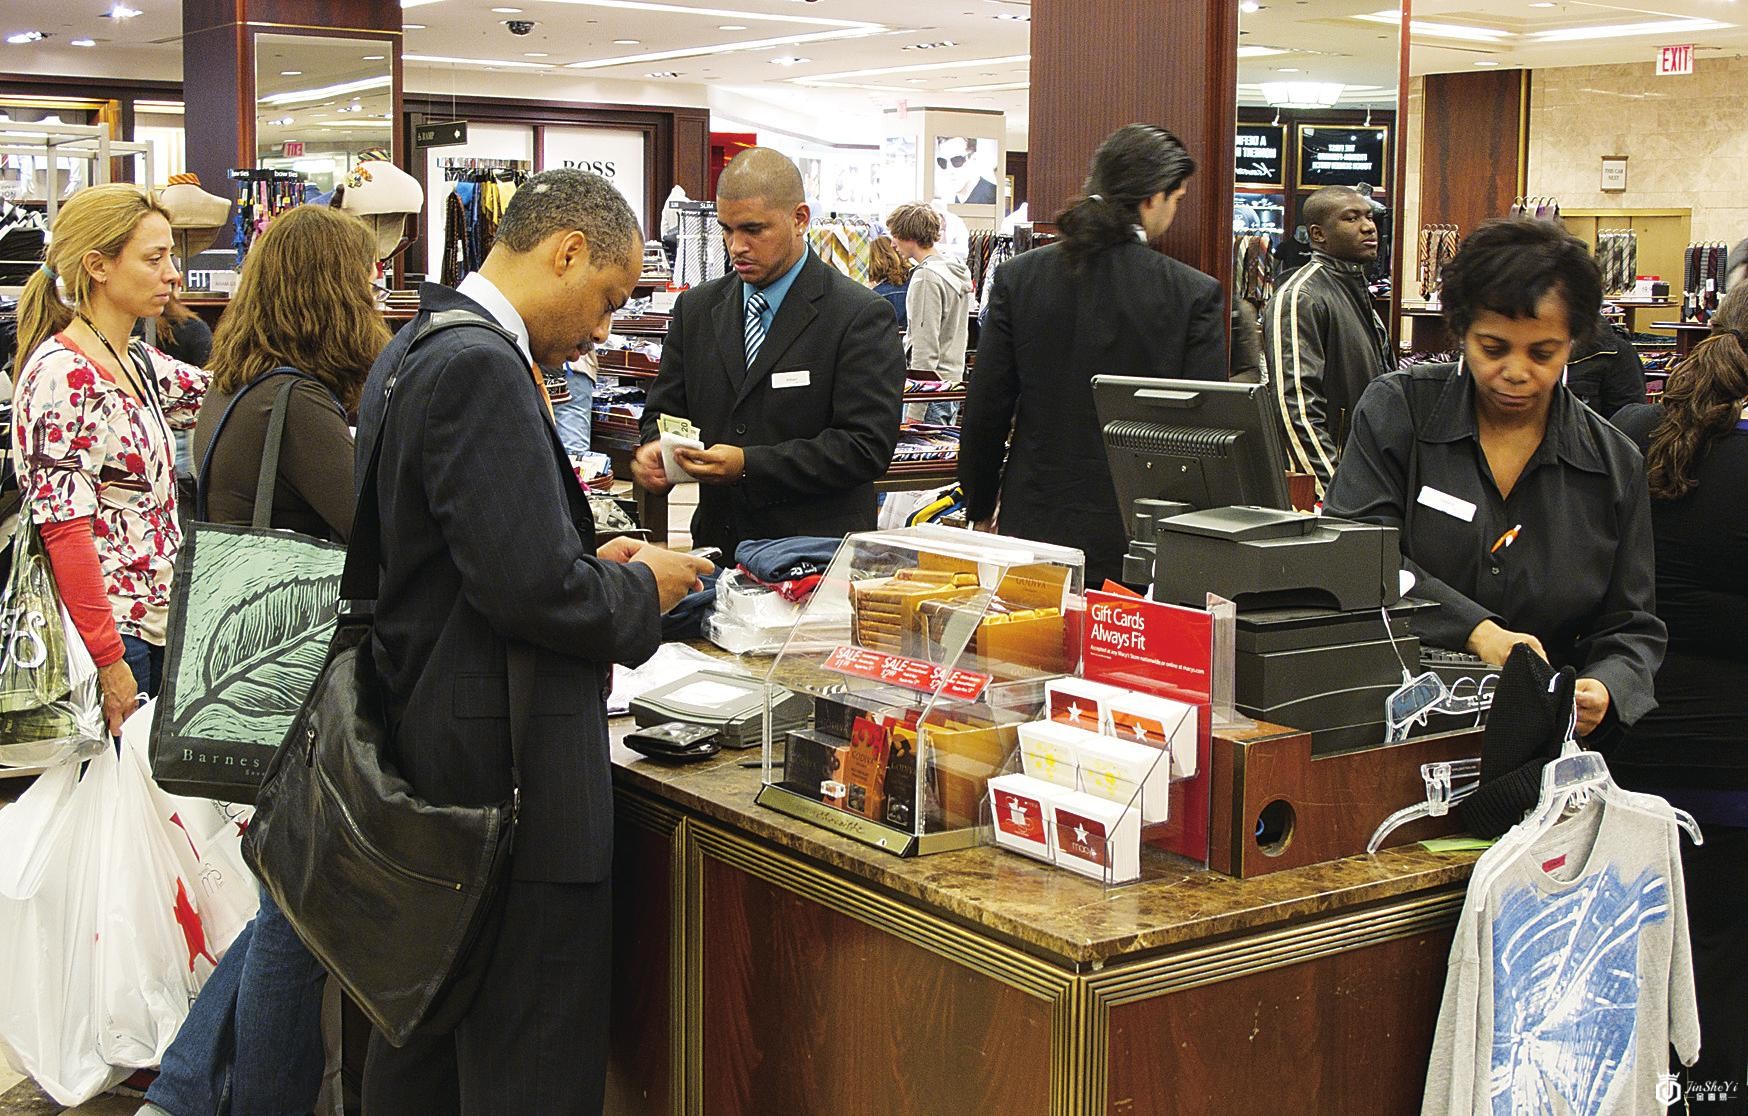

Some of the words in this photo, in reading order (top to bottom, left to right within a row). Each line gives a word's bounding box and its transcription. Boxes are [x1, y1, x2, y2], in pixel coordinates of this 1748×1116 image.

[1662, 47, 1690, 72] EXIT
[1091, 604, 1112, 624] Gift
[1113, 608, 1145, 630] Cards
[1090, 623, 1130, 649] Always
[1131, 631, 1146, 651] Fit
[836, 648, 862, 662] SALE
[881, 657, 909, 672] SALE
[182, 749, 260, 768] Barnes
